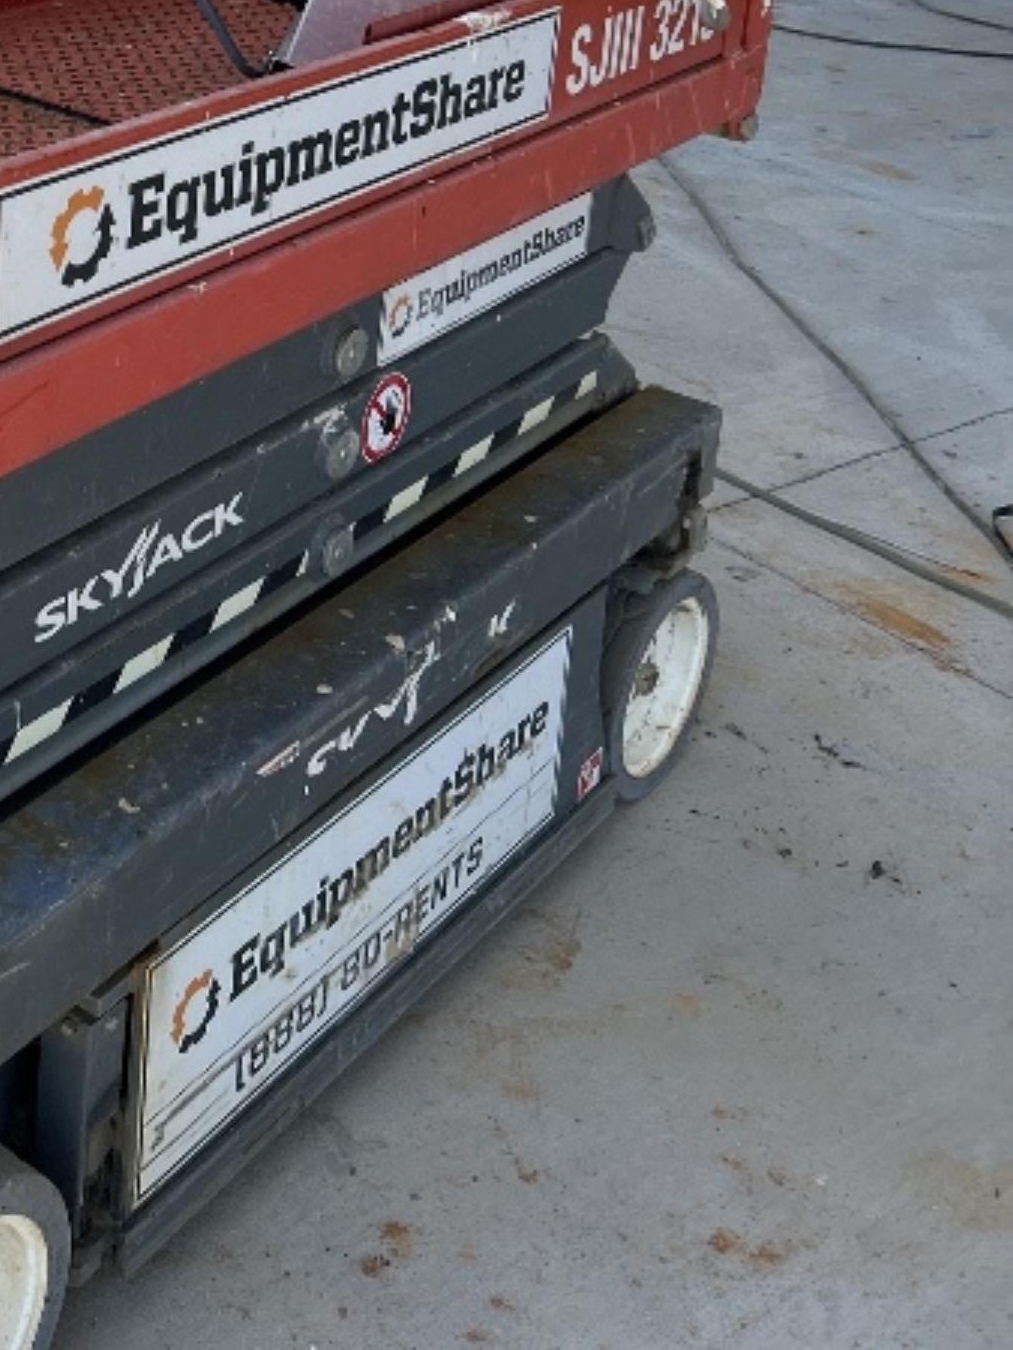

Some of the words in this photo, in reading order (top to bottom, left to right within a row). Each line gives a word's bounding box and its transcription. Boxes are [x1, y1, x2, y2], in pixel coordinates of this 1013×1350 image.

[126, 58, 527, 249] EquipmentShare
[415, 214, 587, 323] EquipmentShare
[34, 491, 245, 644] SKYJACK
[228, 701, 550, 1003] EquipmentShare
